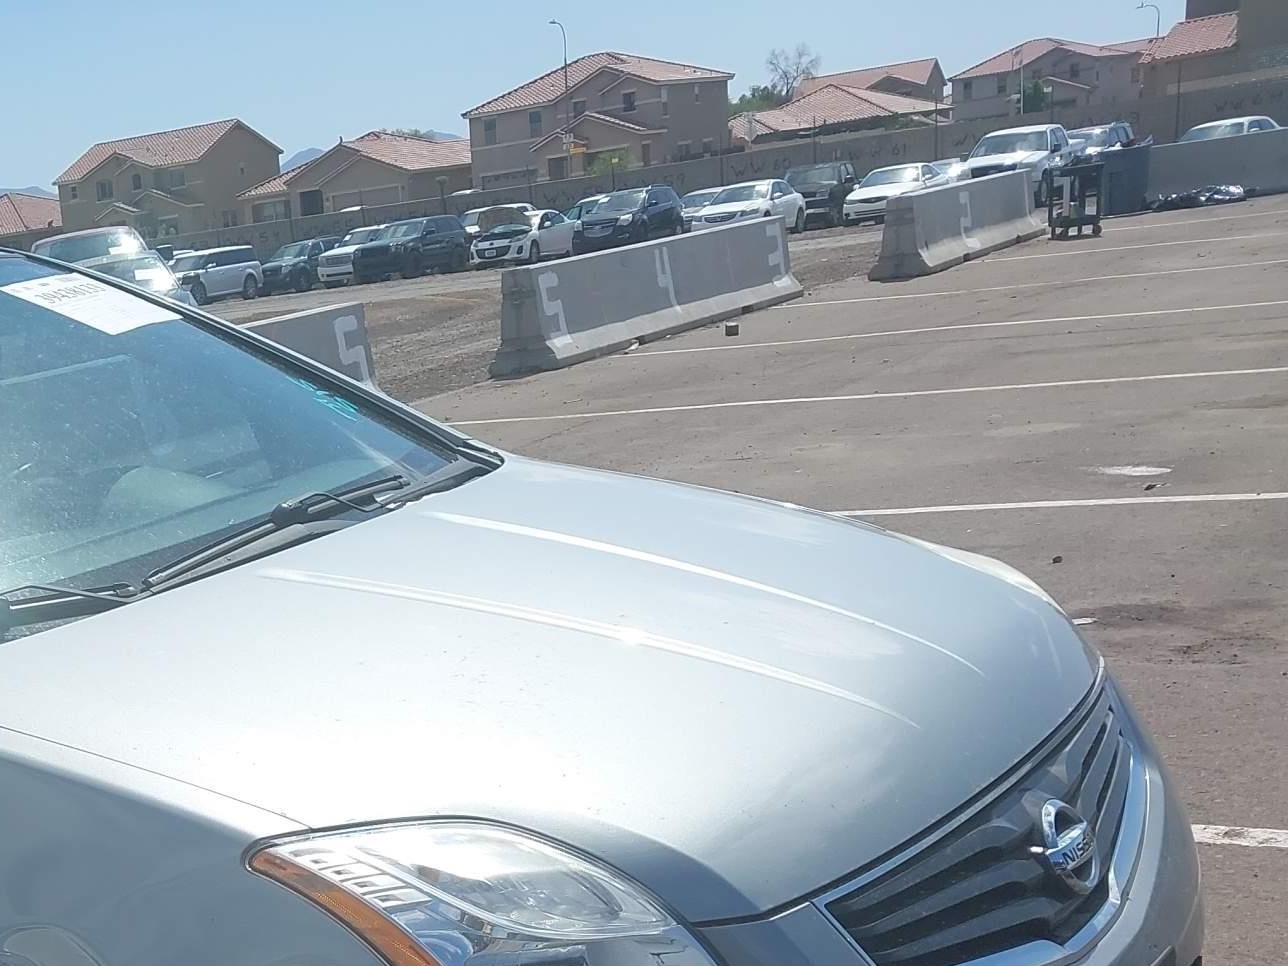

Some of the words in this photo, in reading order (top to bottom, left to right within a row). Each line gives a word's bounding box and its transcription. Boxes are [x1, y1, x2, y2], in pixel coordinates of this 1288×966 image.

[538, 271, 574, 347] 5
[655, 247, 681, 311] 4
[766, 222, 792, 287] 3
[333, 315, 373, 387] 5
